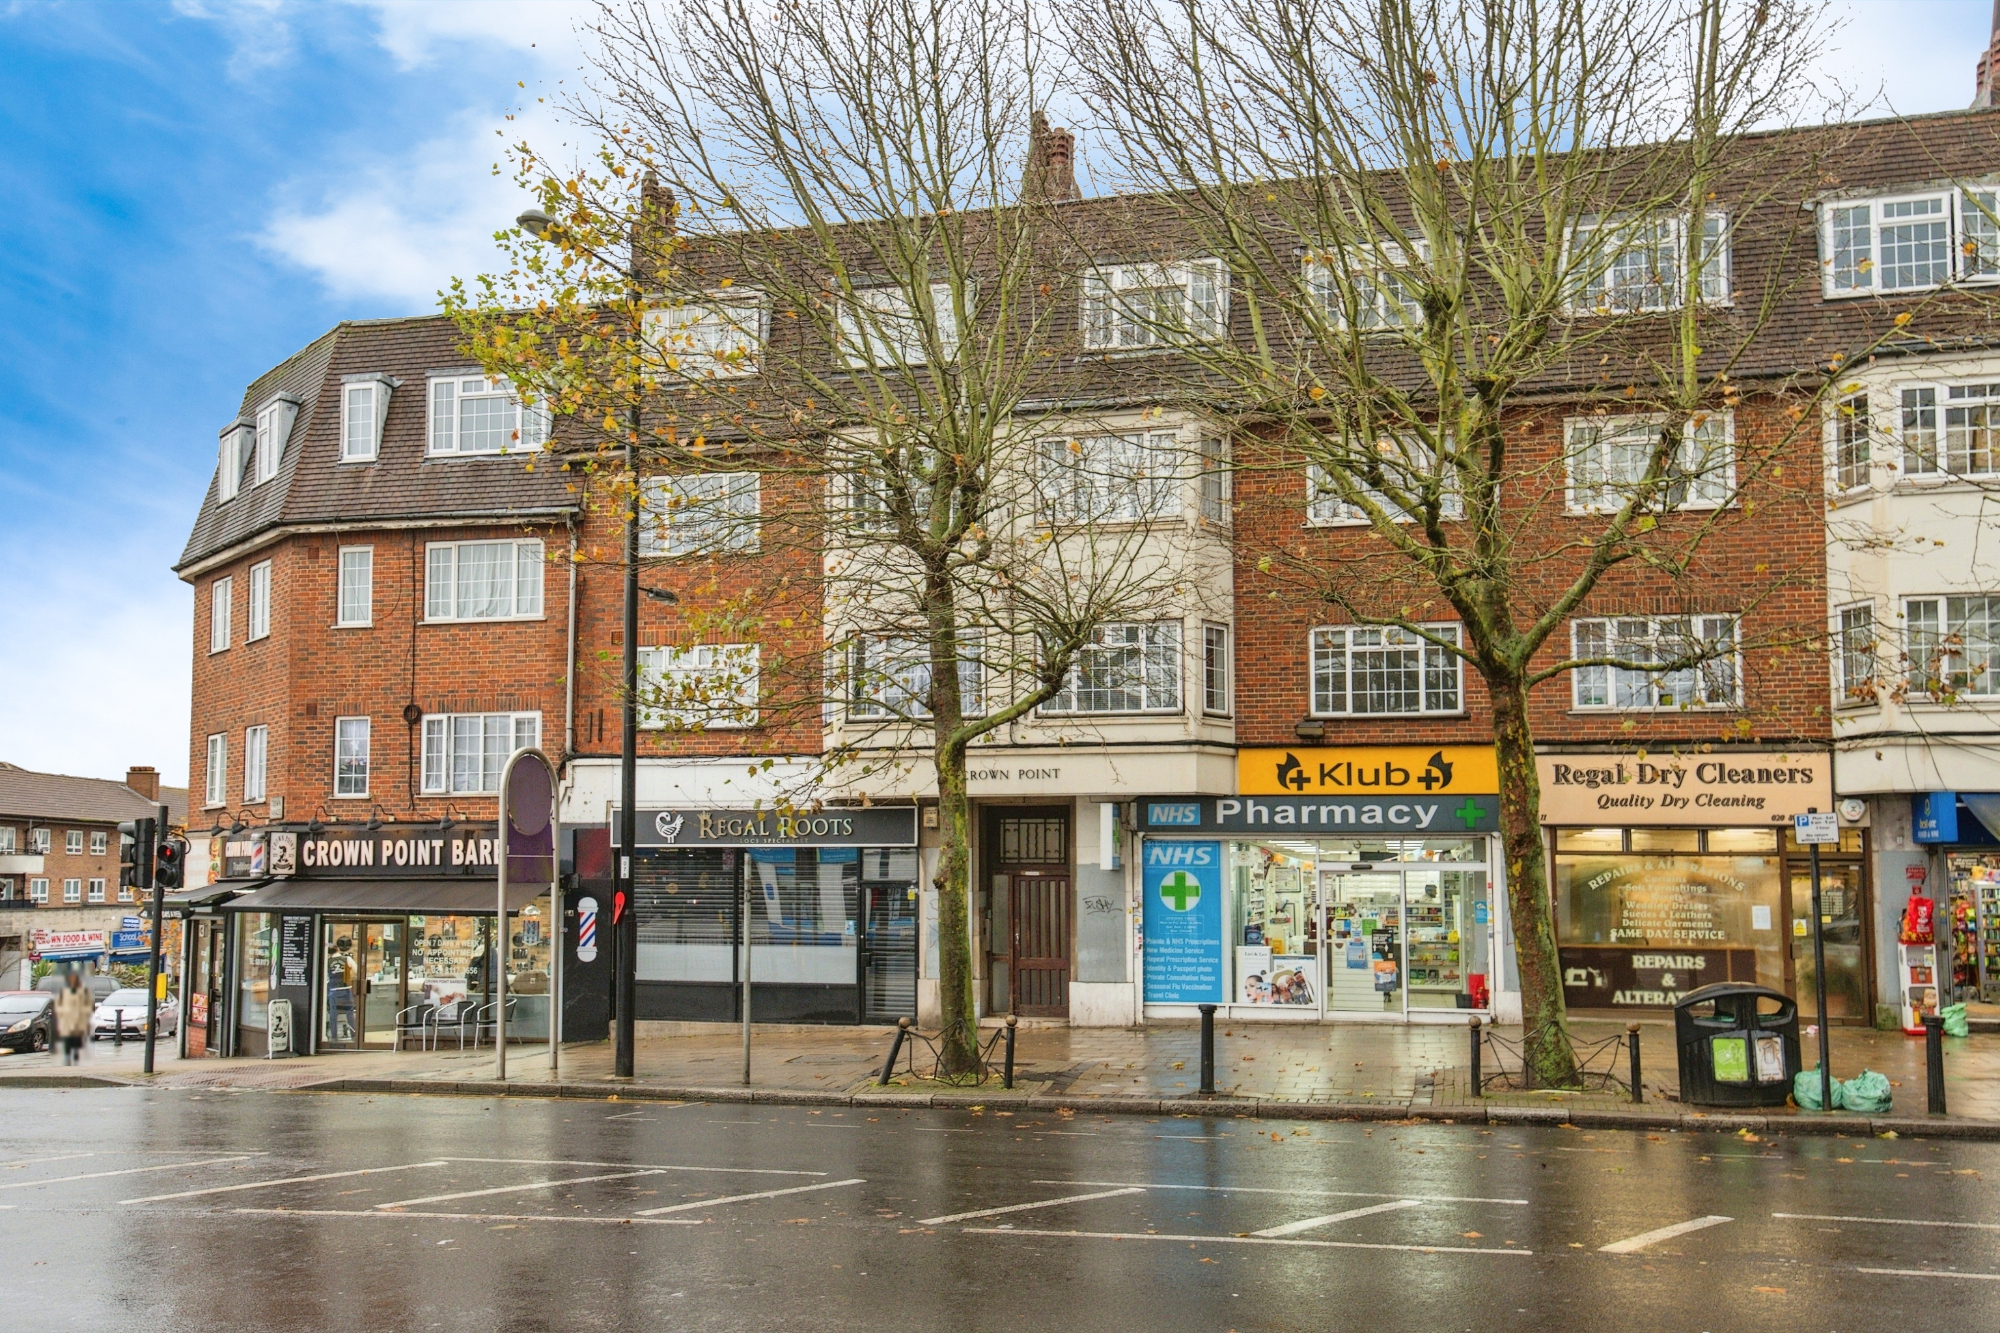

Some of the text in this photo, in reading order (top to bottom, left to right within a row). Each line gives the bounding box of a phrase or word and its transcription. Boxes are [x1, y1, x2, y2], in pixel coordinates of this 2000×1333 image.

[965, 768, 1061, 780] ROWN POINT
[1319, 762, 1410, 786] Klub
[1553, 762, 1814, 788] Regal Dry Cleaners
[1597, 793, 1766, 810] Quality Dry Cleaning
[1151, 800, 1438, 829] NHS Pharmacy
[303, 840, 374, 866] CROWN
[382, 839, 444, 866] POINT
[1148, 846, 1212, 865] NHS
[1588, 860, 1745, 892] REPAIRS & ALTERATIONS
[1645, 875, 1687, 883] Curtains
[1648, 884, 1707, 893] Furnishings
[1626, 902, 1708, 911] Wedding Dresses
[1622, 910, 1657, 918] Suedes
[1669, 911, 1712, 919] Leathers
[1622, 919, 1713, 928] Delicate Garments
[63, 934, 81, 943] FOOD
[82, 934, 87, 942] &
[87, 932, 103, 941] WINE
[119, 933, 138, 942] School
[1610, 928, 1725, 940] SAME DAY SERVICE
[1185, 938, 1219, 946] Prescriptions
[1166, 956, 1197, 964] Prescription
[1632, 954, 1706, 970] REPAIRS
[1173, 965, 1196, 973] Passport
[1661, 972, 1677, 987] &
